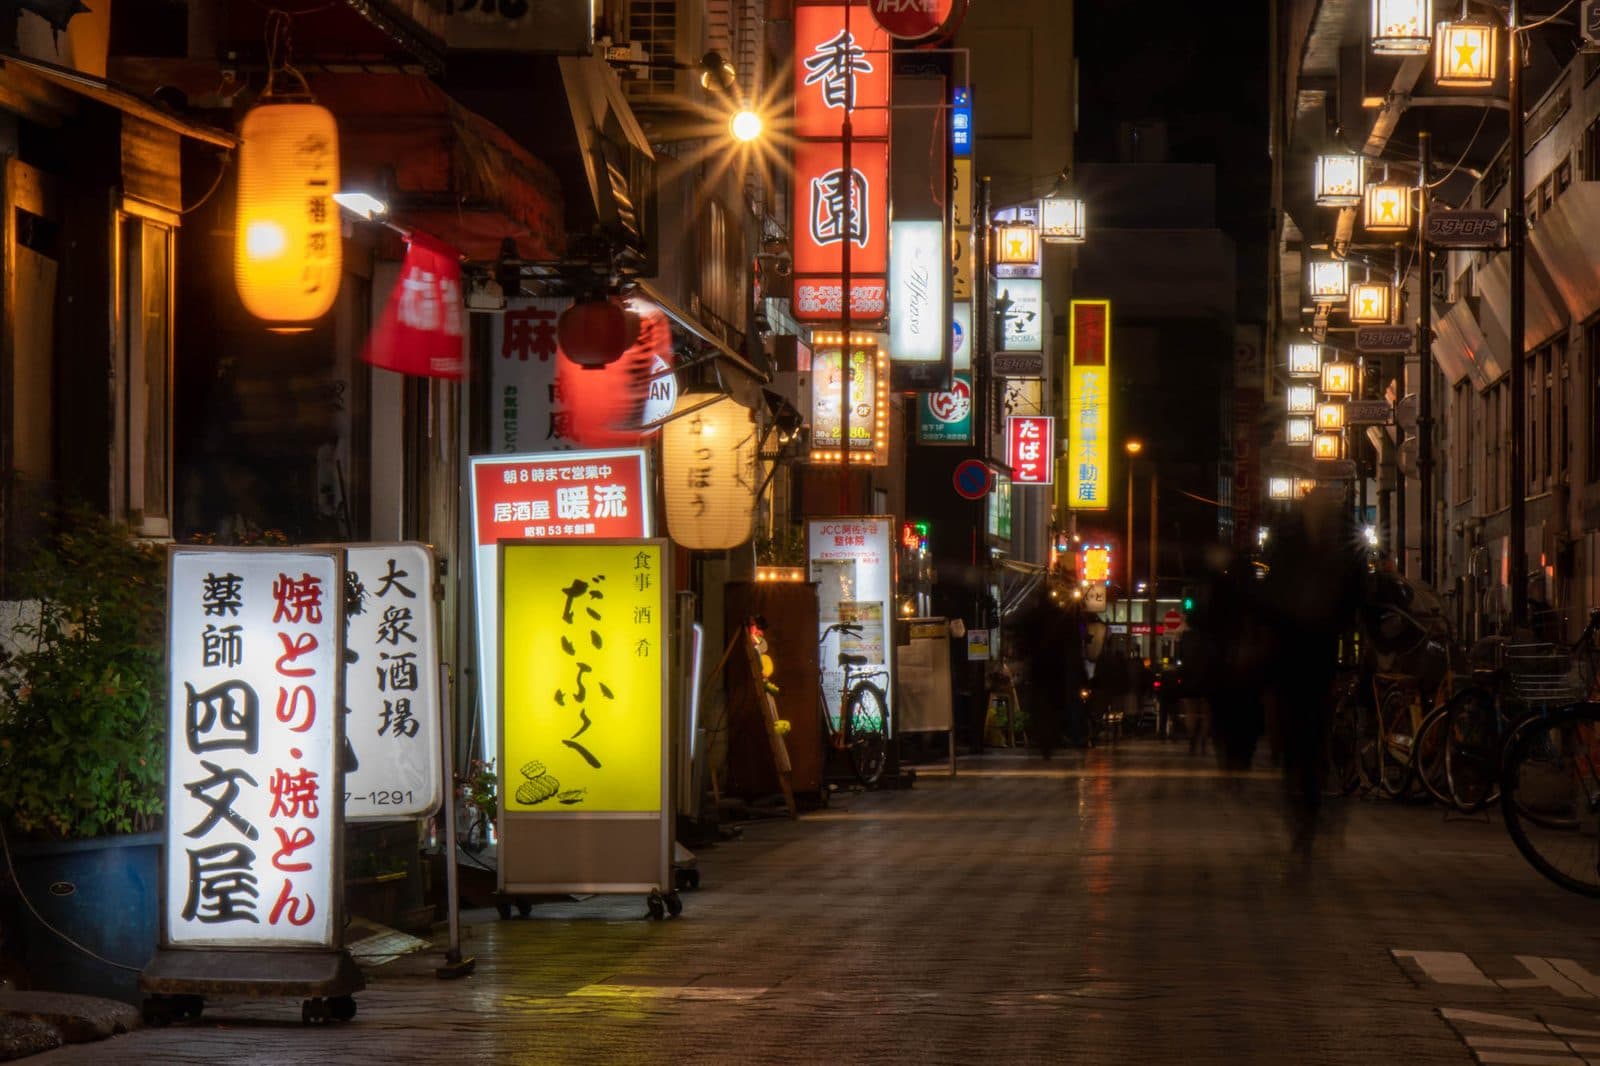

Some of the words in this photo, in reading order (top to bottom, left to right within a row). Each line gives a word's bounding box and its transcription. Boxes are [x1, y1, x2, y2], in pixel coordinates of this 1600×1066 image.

[503, 465, 612, 485] 朝8時まで営業中
[1018, 419, 1041, 481] たばこ
[493, 500, 550, 523] 居酒屋
[556, 484, 628, 520] 暖流
[632, 551, 652, 592] 食事
[201, 573, 245, 668] 薬師
[633, 606, 652, 625] 酒
[374, 558, 420, 739] 大衆酒場
[554, 575, 615, 769] だいふく
[634, 639, 650, 657] 肴
[269, 572, 323, 927] 焼とり・焼とん
[182, 679, 260, 925] 四文屋
